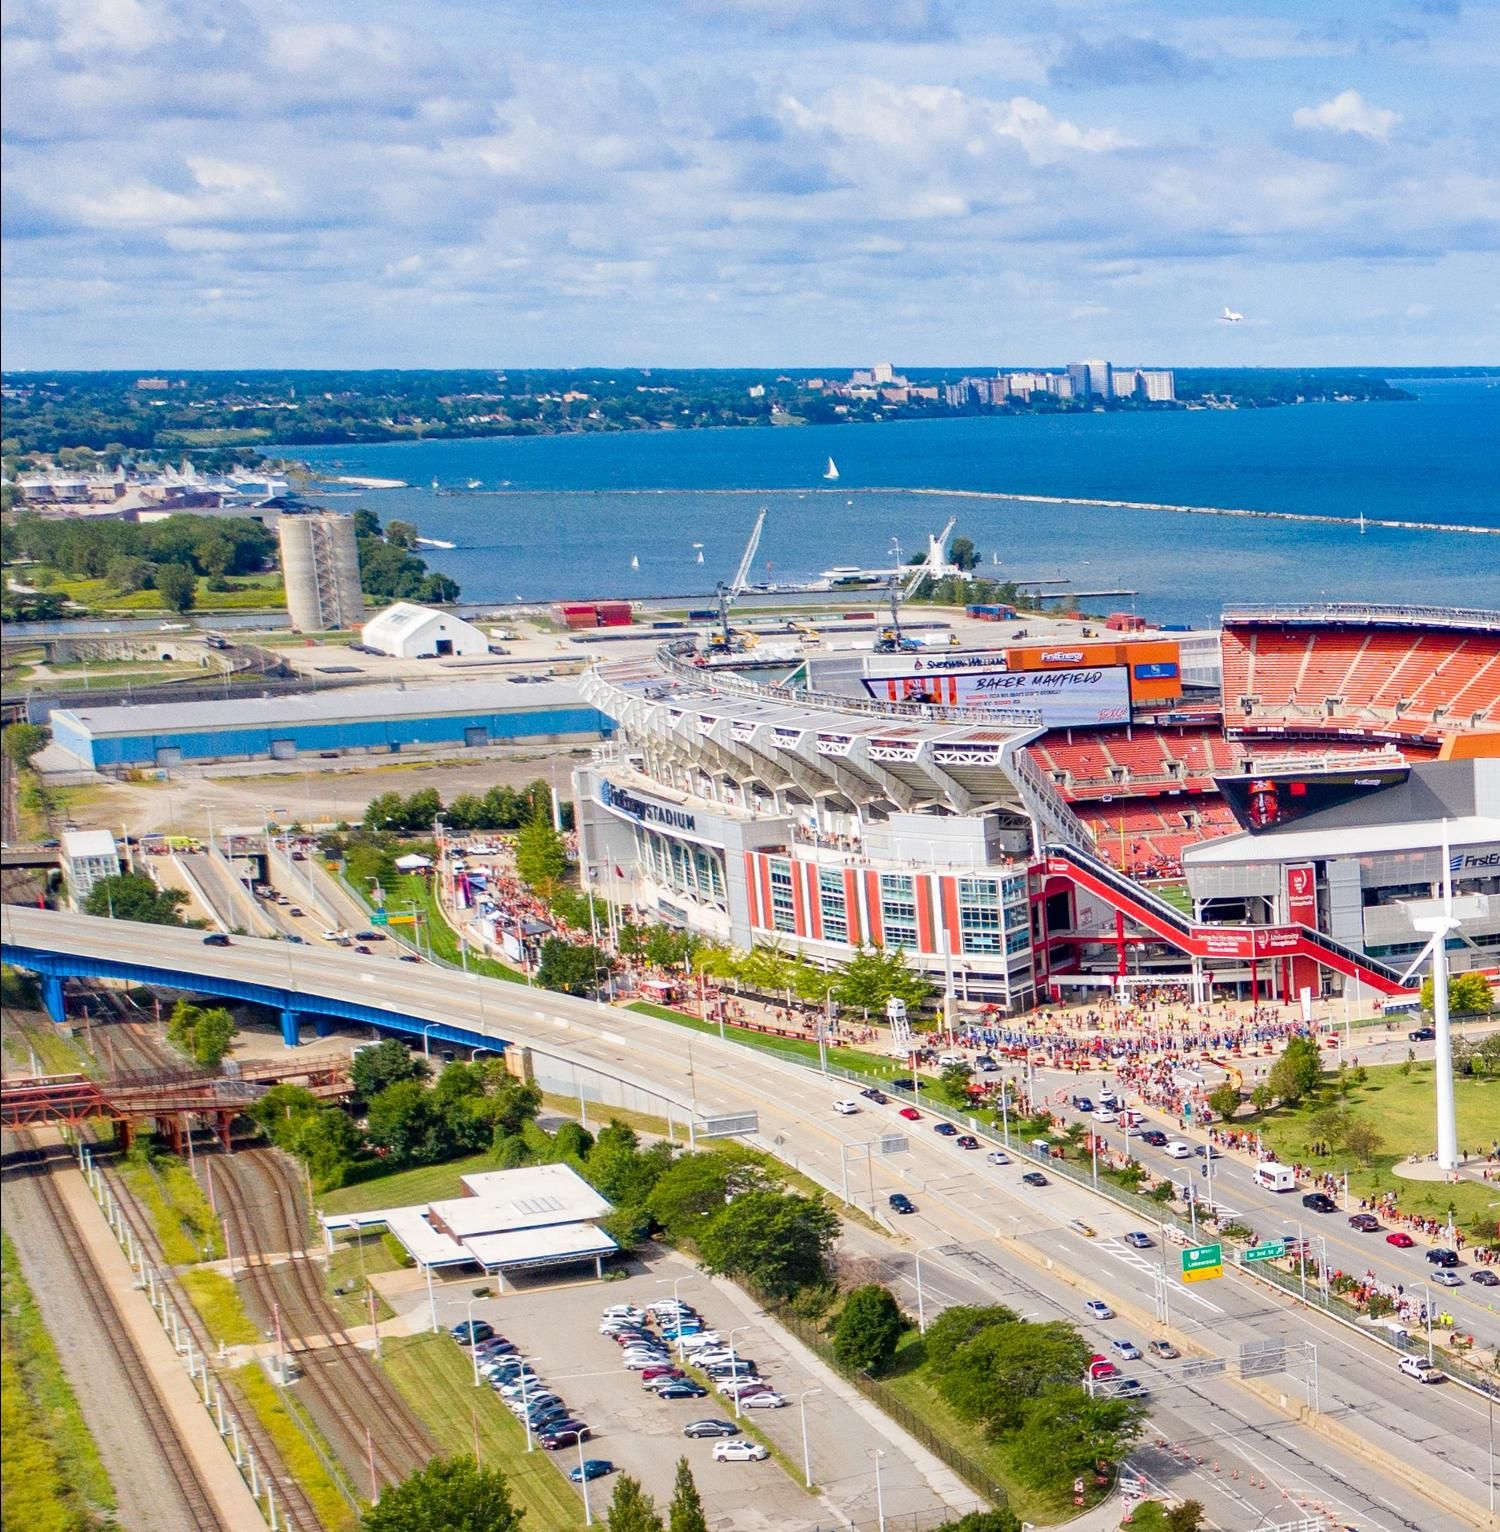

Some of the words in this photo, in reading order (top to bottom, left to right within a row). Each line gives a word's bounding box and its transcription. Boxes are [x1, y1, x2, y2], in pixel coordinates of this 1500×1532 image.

[1041, 651, 1084, 662] FirstEnergy
[975, 676, 1026, 690] BAKER
[1031, 671, 1103, 688] MAYFIELD
[646, 803, 696, 831] STADIUM
[1270, 933, 1299, 941] University
